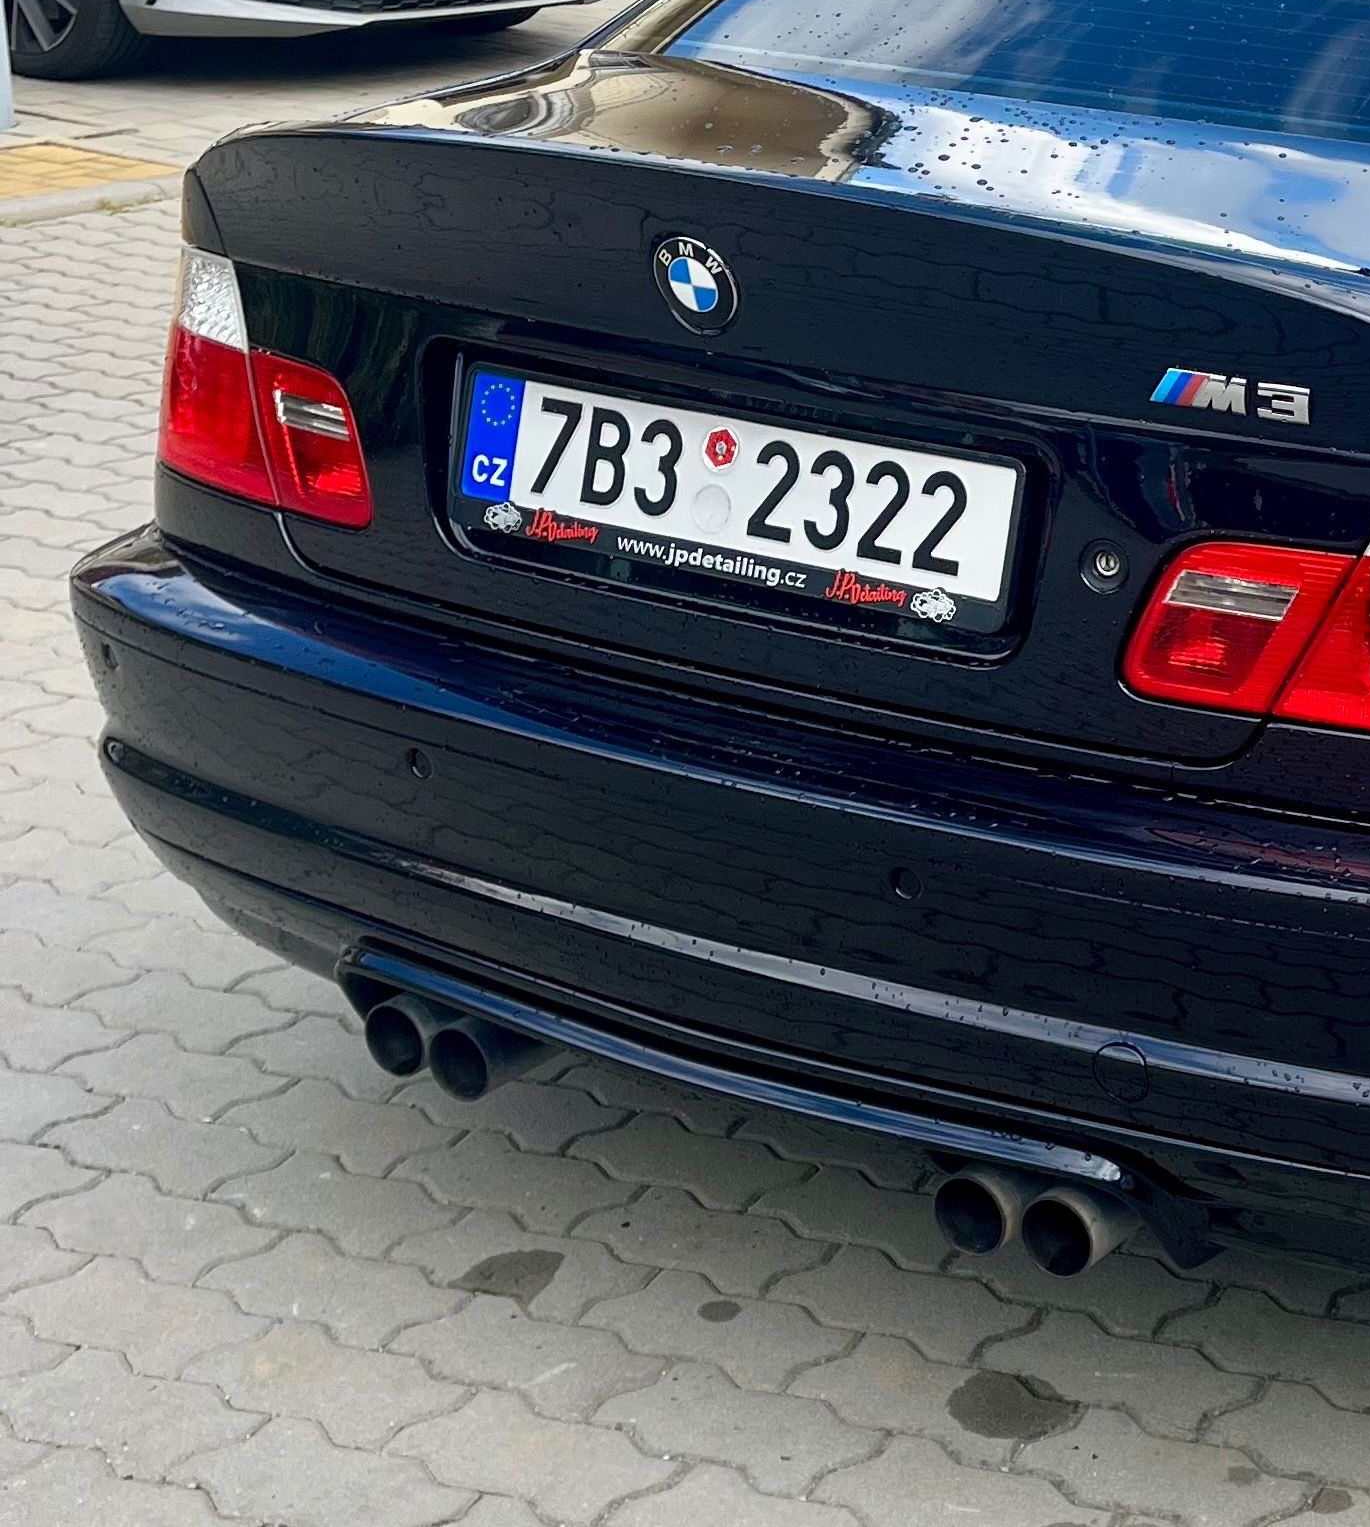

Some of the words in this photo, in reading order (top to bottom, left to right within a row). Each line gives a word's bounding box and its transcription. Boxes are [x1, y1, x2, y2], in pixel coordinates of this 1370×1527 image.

[658, 240, 723, 275] BMW
[1190, 374, 1311, 425] M3
[472, 453, 510, 487] CZ
[529, 396, 684, 517] 7B3
[745, 440, 968, 577] 2322
[617, 536, 807, 589] www.jpdetailing.cz
